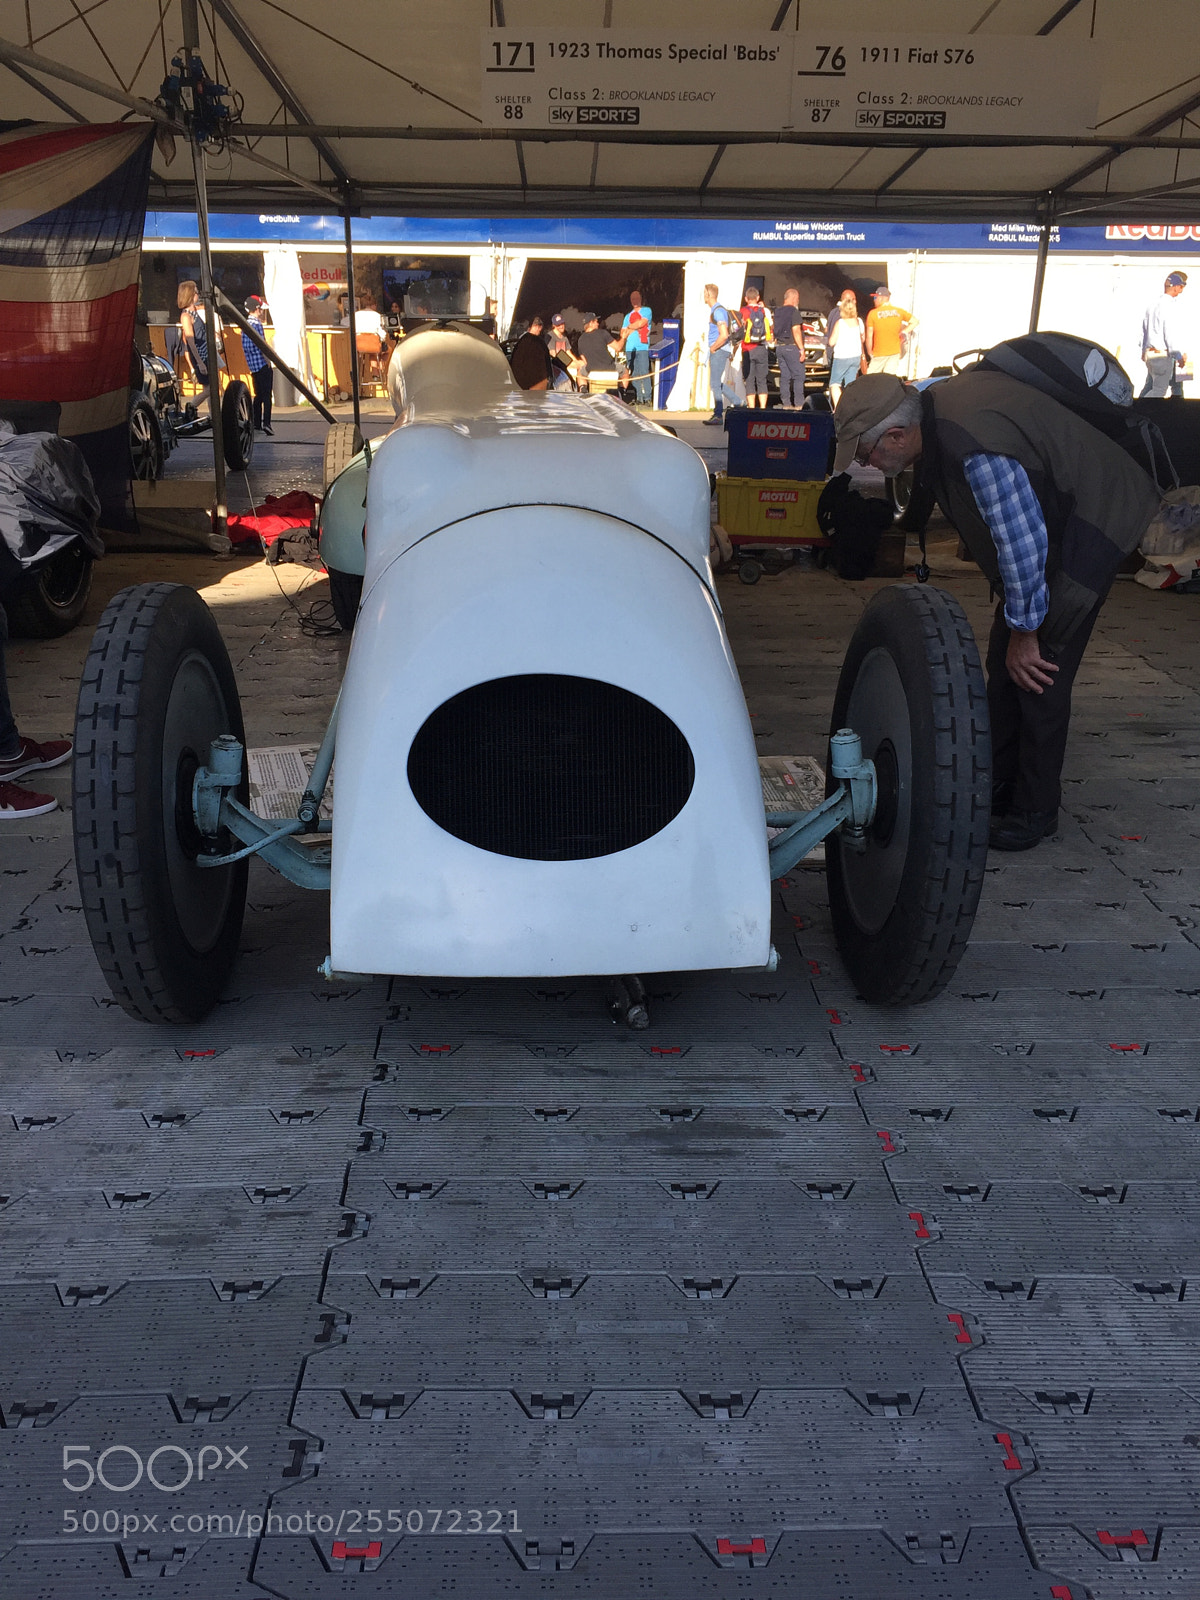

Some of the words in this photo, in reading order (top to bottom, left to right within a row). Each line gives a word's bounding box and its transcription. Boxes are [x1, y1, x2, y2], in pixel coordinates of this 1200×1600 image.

[492, 42, 535, 66] 171
[548, 42, 590, 58] 1923
[596, 43, 662, 60] Thomas
[668, 44, 727, 63] Special
[733, 45, 780, 62] 'Babs'
[815, 46, 846, 71] 76
[861, 47, 901, 63] 1911
[908, 48, 938, 64] Fiat
[944, 49, 974, 65] S76
[495, 95, 532, 104] SHELTER
[548, 87, 586, 101] Class
[593, 88, 605, 101] 2:
[609, 90, 676, 101] BROOKLANDS
[678, 91, 716, 102] LEGACY
[857, 91, 894, 105] Class
[901, 93, 913, 105] 2:
[917, 95, 983, 106] BROOKLANDS
[985, 96, 1023, 107] LEGACY
[804, 98, 840, 107] SHELTER
[504, 105, 524, 120] 88
[551, 108, 574, 122] sky
[579, 109, 637, 121] SPORTS
[811, 109, 831, 123] 87
[859, 112, 881, 126] sky
[886, 113, 943, 126] SPORTS
[259, 214, 300, 223] @redbulluk
[775, 222, 791, 231] Mad
[793, 222, 809, 231] Mike
[811, 222, 844, 231] Whiddett
[991, 224, 1007, 232] Mad
[1008, 224, 1025, 232] Mike
[753, 232, 782, 241] RUMBUL
[816, 233, 845, 241] Stadium
[846, 233, 865, 241] Truck
[988, 233, 1017, 242] RADBUL
[320, 267, 342, 281] Bull
[751, 424, 807, 438] MOTUL
[761, 491, 796, 501] MOTUL
